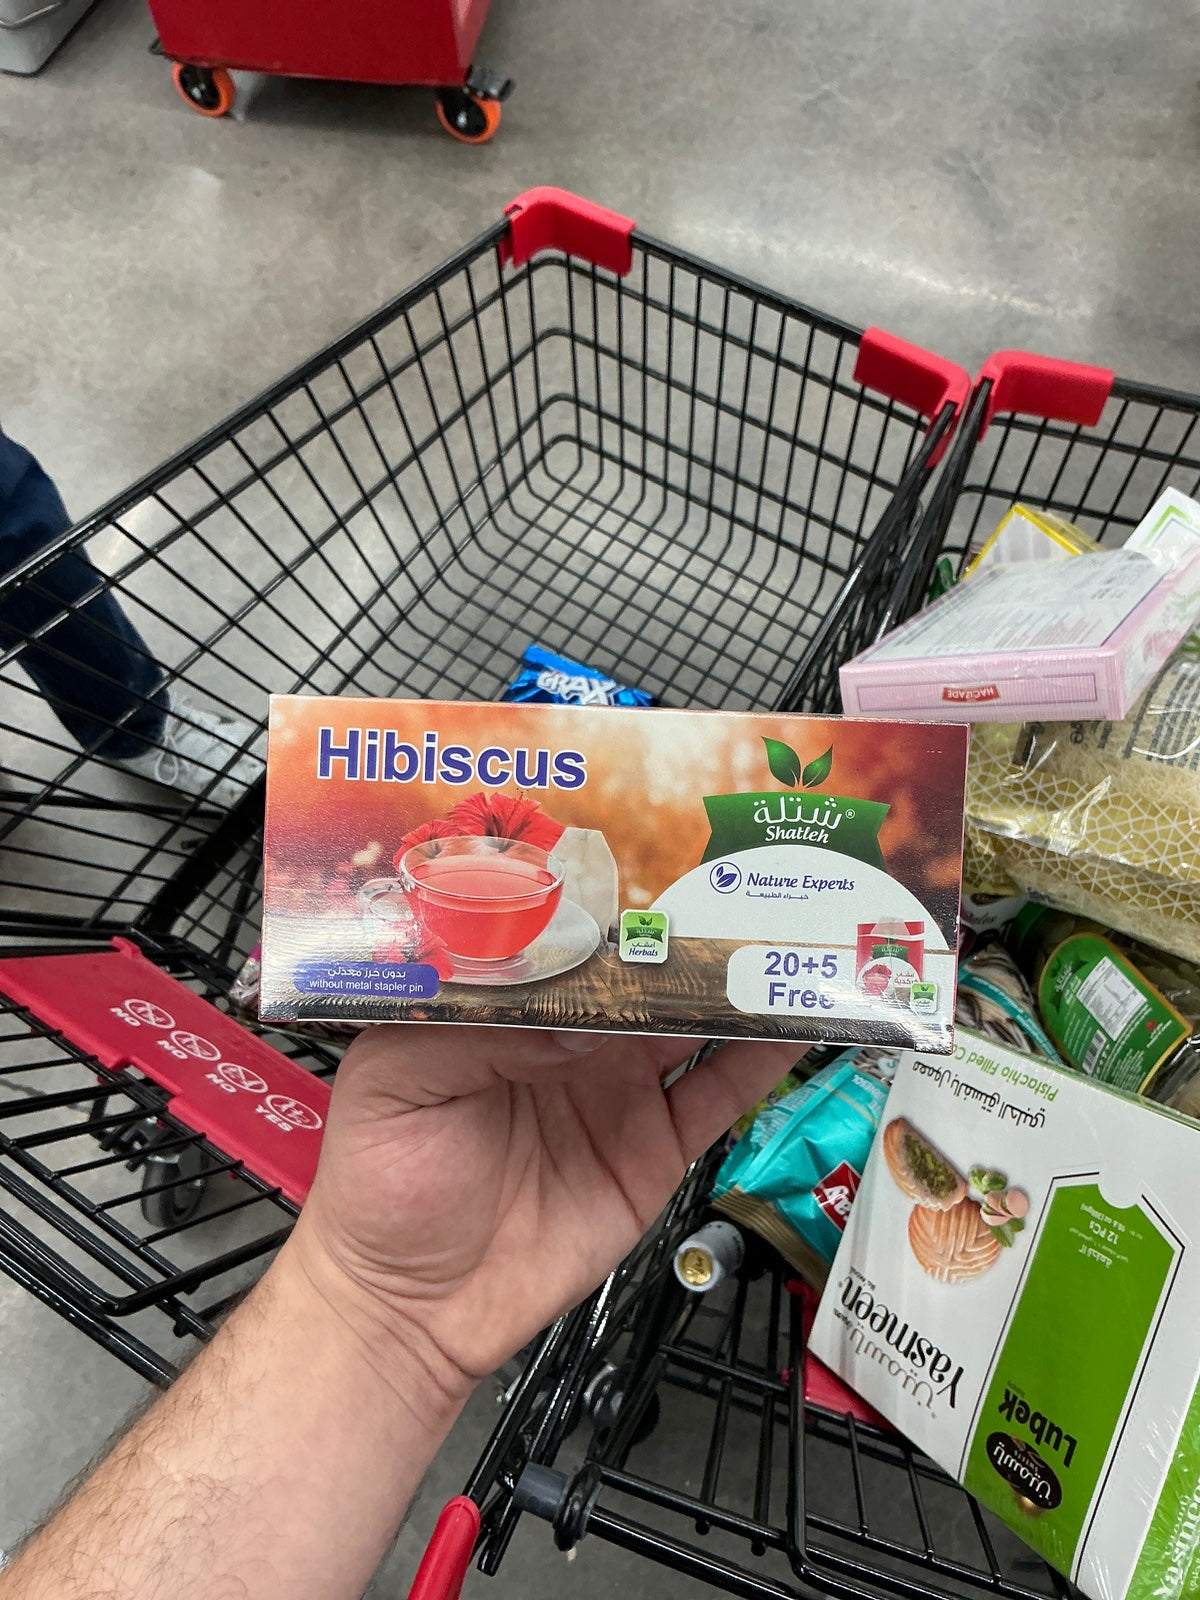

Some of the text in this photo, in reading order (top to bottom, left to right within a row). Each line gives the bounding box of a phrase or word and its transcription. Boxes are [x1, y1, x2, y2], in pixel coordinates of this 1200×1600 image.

[318, 727, 588, 791] Hibiscus
[753, 796, 843, 830] شتلة
[765, 825, 829, 844] Shatleh
[746, 872, 856, 892] Nature Experts
[628, 947, 658, 957] Herbals
[764, 951, 838, 978] 20+5
[309, 978, 424, 994] without metal stapler pin
[382, 969, 406, 981] بدون
[768, 982, 836, 1010] Free
[111, 1007, 141, 1027] NO
[157, 1040, 188, 1060] NO
[966, 1052, 999, 1076] Filled
[205, 1073, 237, 1093] NO
[913, 1060, 1046, 1129] معمول بالفستق الحلبي
[1001, 1066, 1059, 1102] Pistachio
[256, 1104, 294, 1132] YES
[842, 1276, 964, 1409] Yasmeen
[998, 1388, 1078, 1468] Lubek
[992, 1440, 1052, 1500] ياسمين
